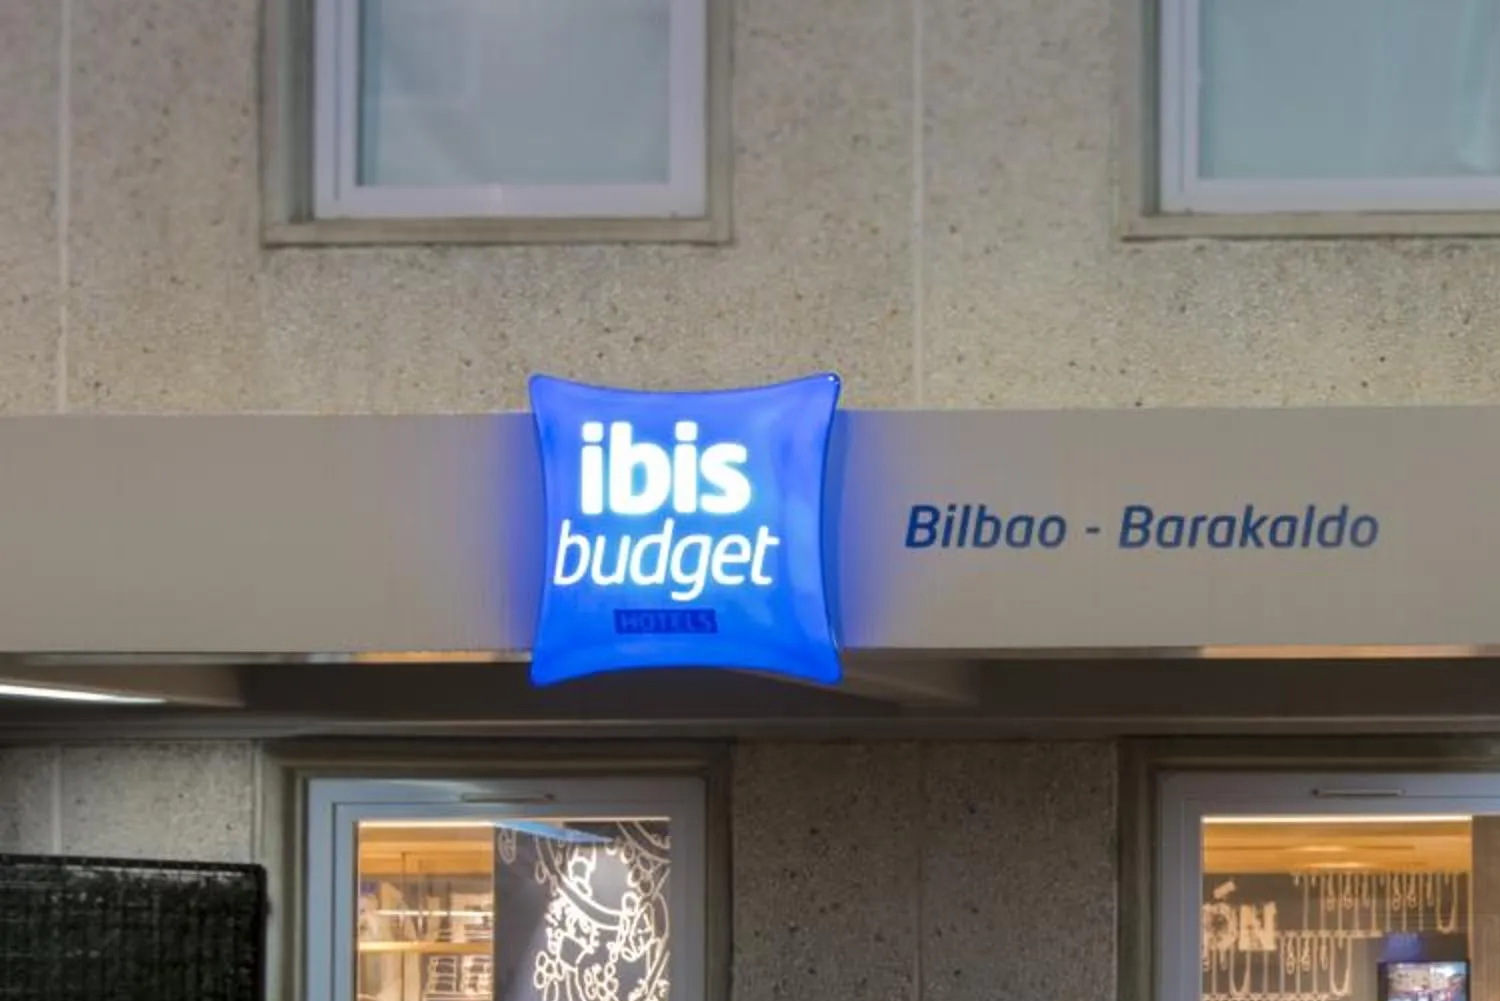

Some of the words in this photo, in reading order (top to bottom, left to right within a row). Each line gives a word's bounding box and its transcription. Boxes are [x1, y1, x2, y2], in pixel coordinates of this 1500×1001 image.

[581, 421, 751, 515] ibis
[905, 505, 1066, 549] Bilbao
[1118, 505, 1379, 549] Barakaldo
[553, 519, 779, 601] budget
[620, 611, 714, 632] HOTELS
